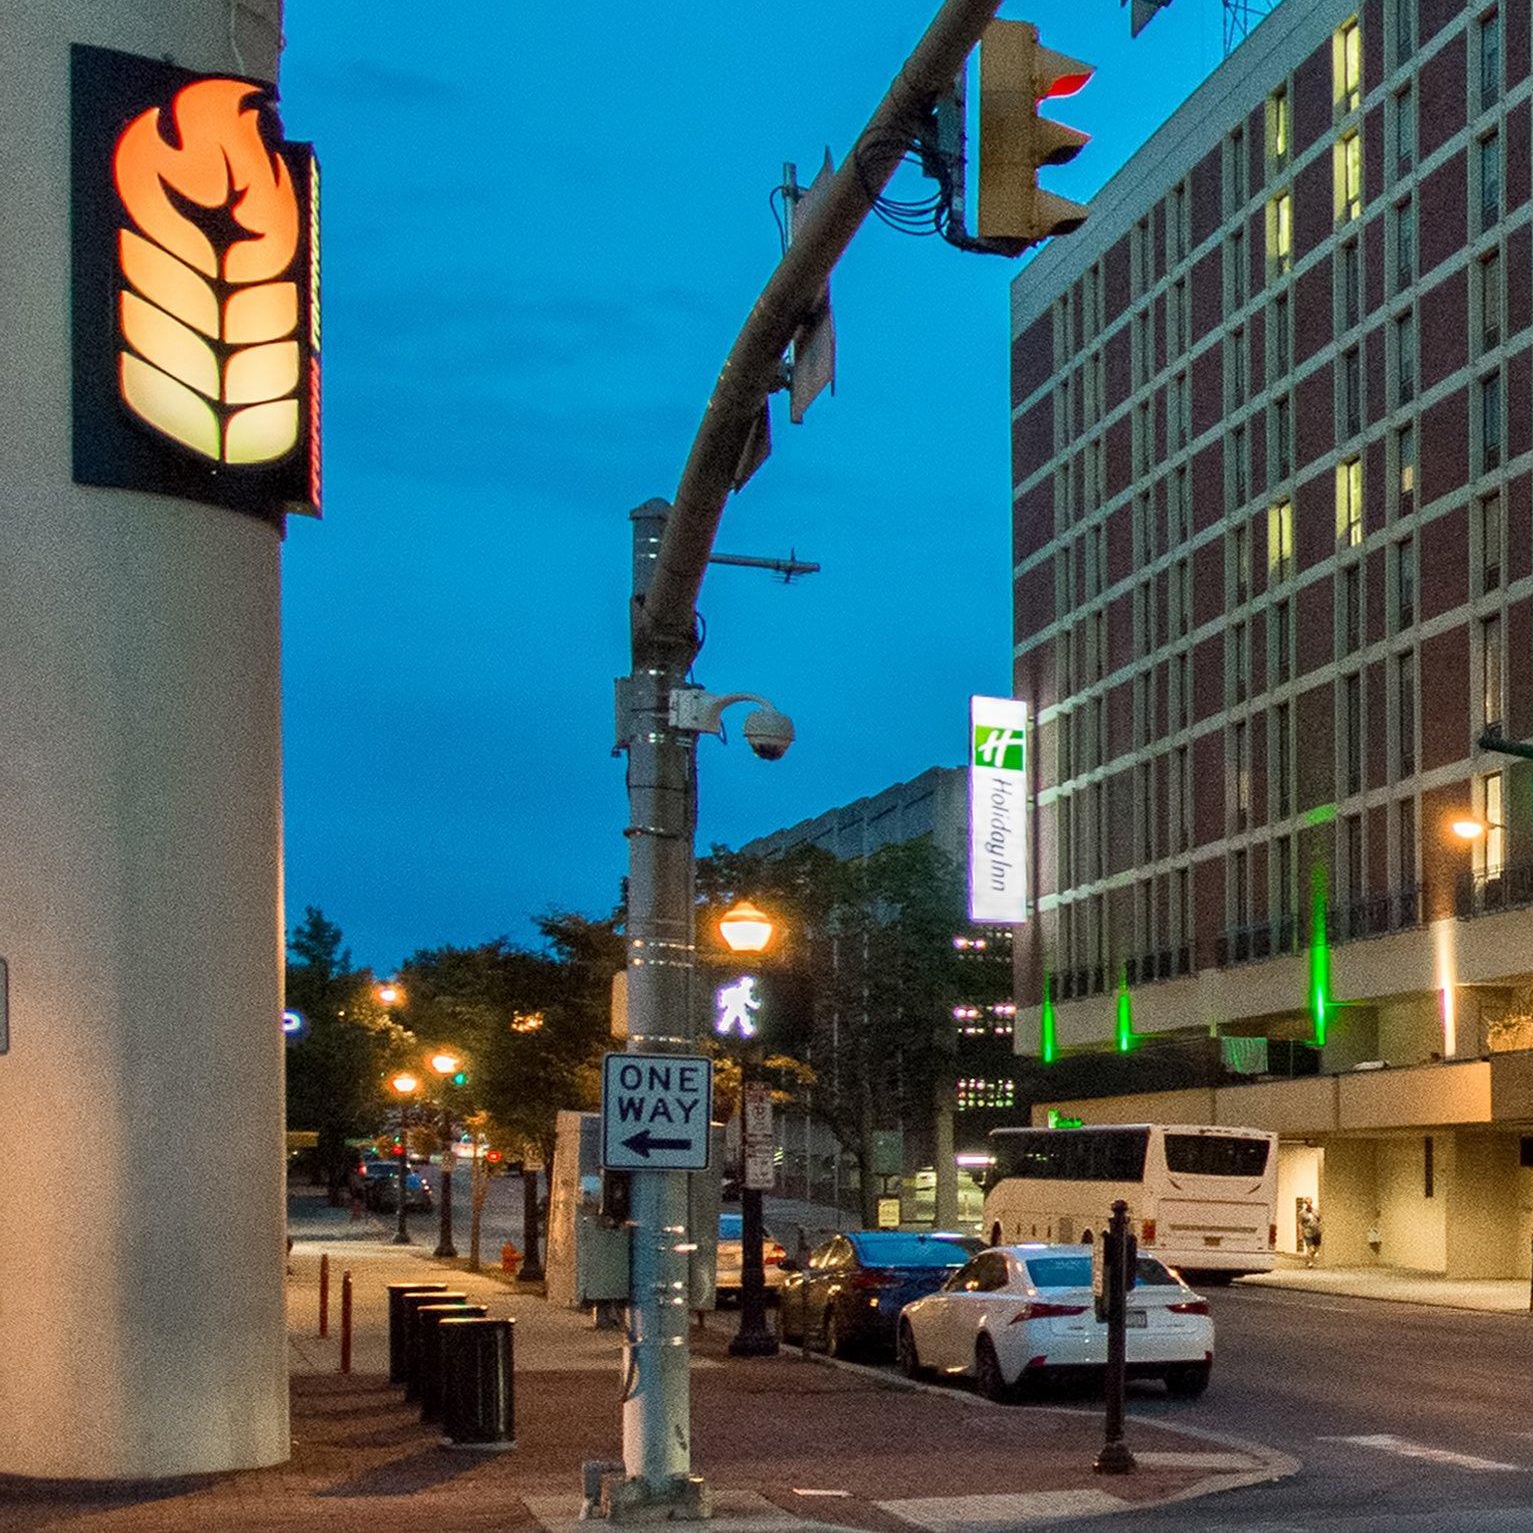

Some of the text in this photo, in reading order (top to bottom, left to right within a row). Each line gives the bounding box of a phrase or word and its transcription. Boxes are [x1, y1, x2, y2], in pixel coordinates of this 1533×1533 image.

[985, 778, 1012, 892] Holiday Inn
[620, 1065, 699, 1092] ONE
[618, 1096, 699, 1123] WAY
